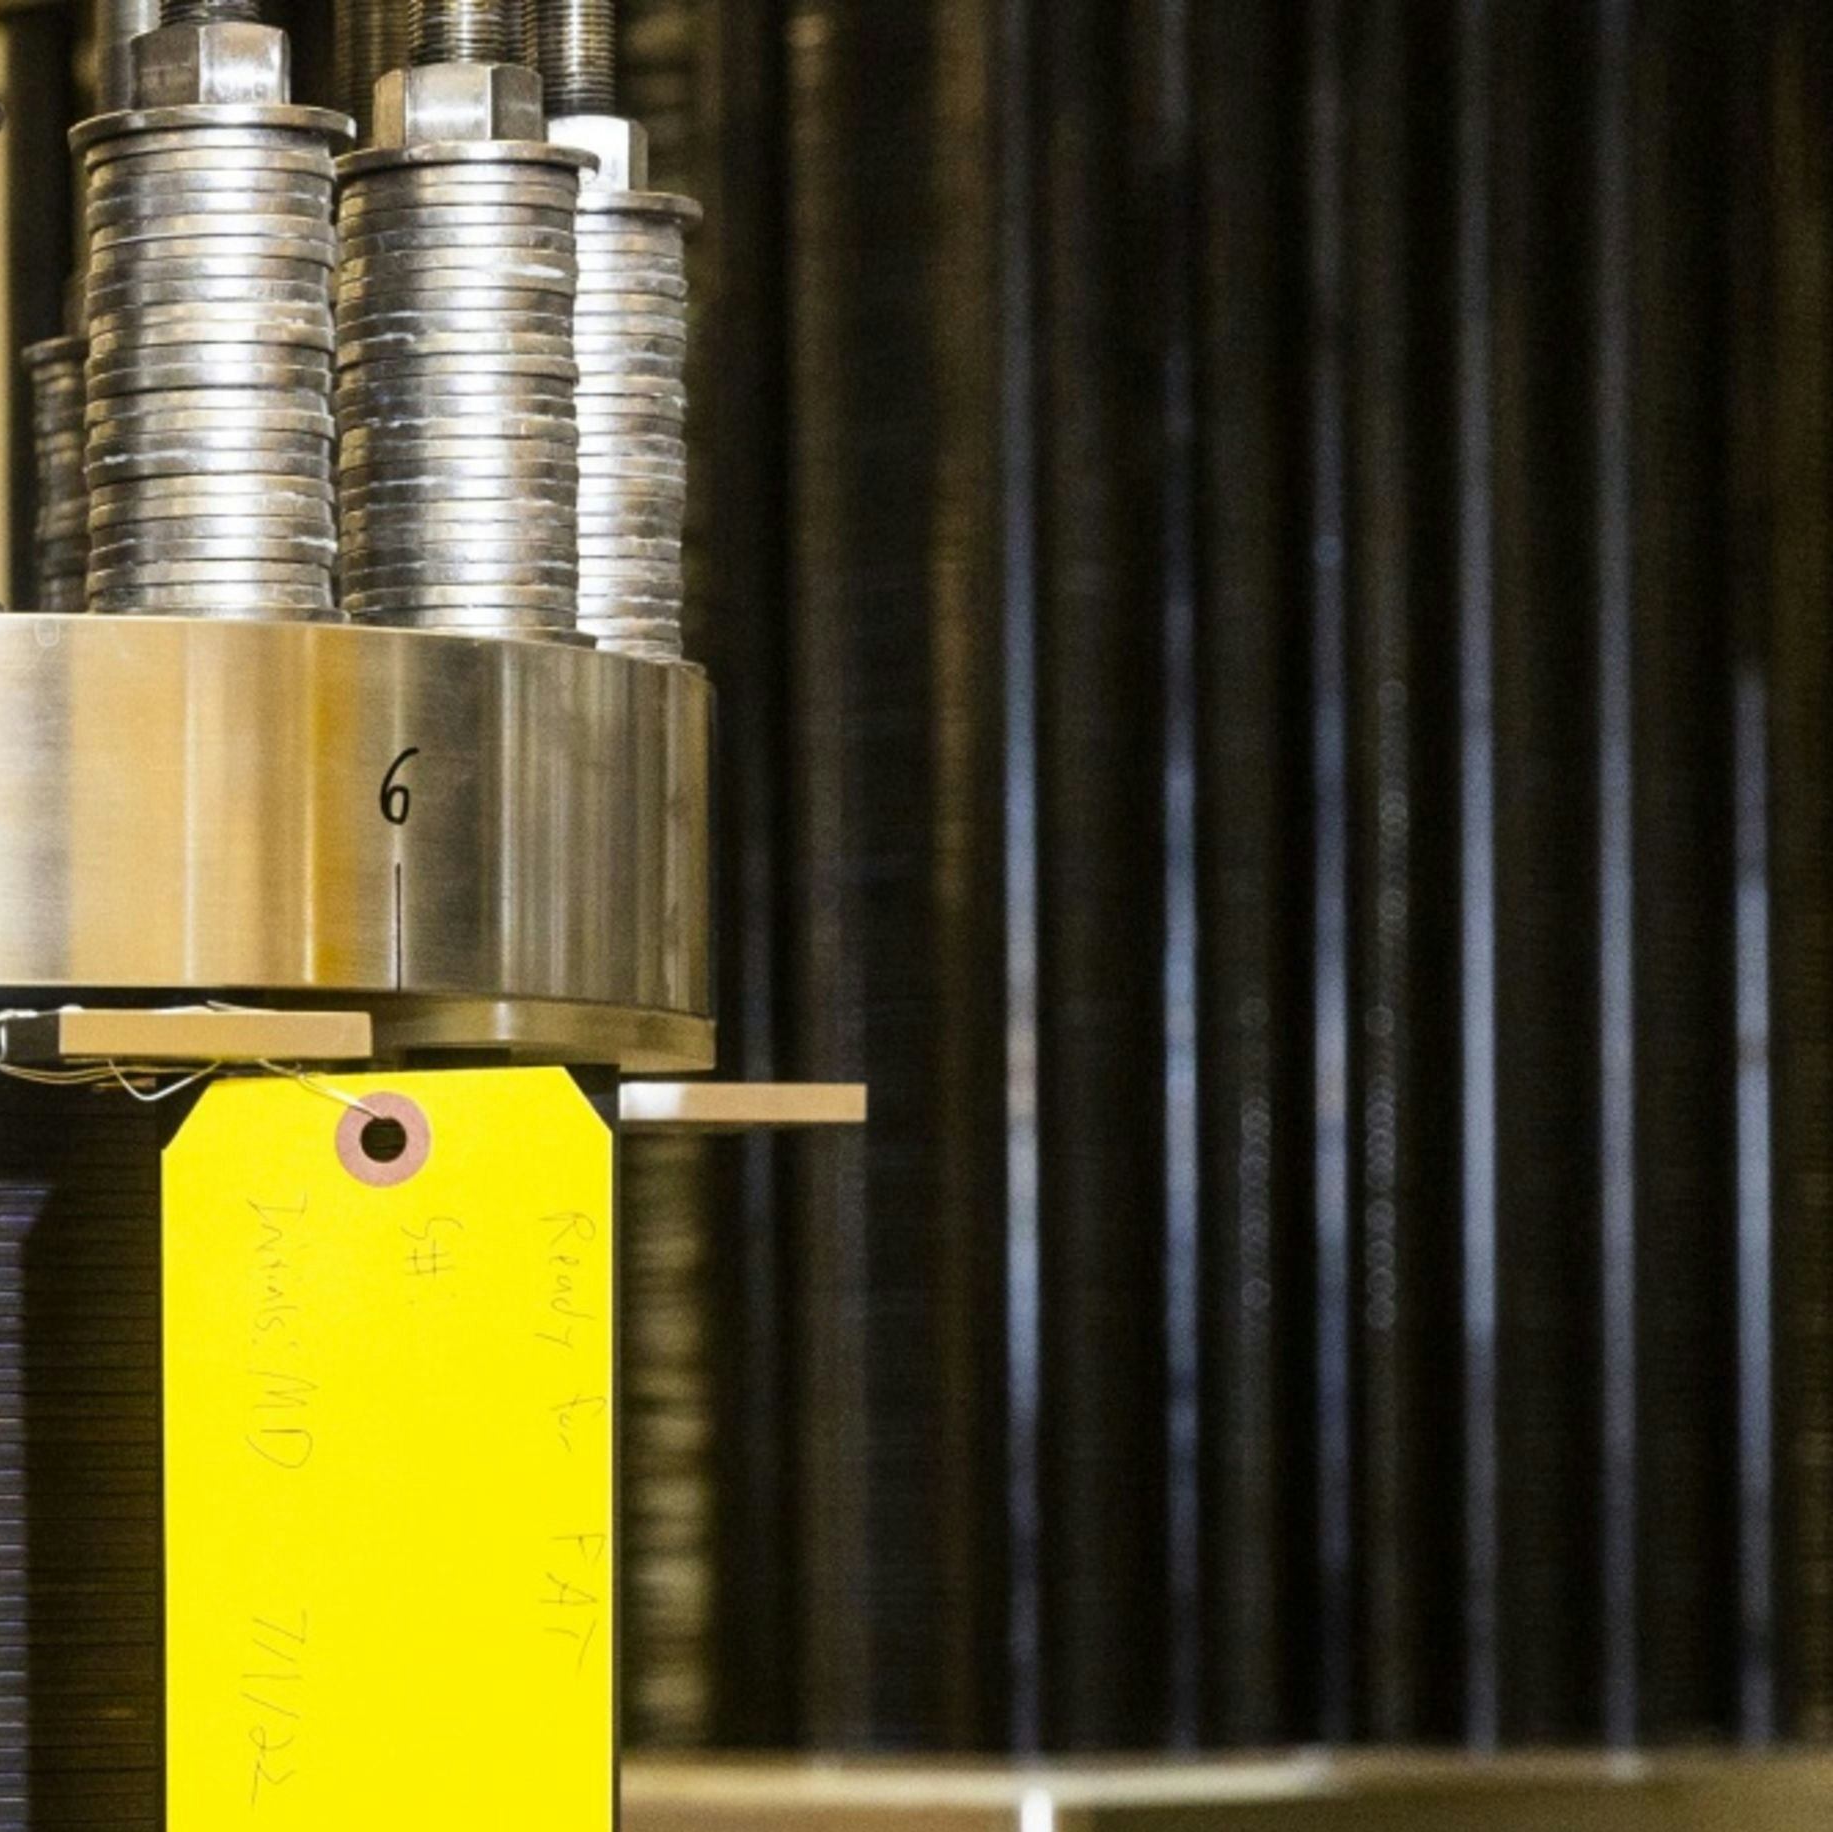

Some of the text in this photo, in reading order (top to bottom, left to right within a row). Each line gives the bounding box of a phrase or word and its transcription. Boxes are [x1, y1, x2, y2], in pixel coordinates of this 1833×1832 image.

[380, 746, 420, 825] 6
[245, 1369, 319, 1470] MD
[534, 1211, 608, 1678] Ready for FAT
